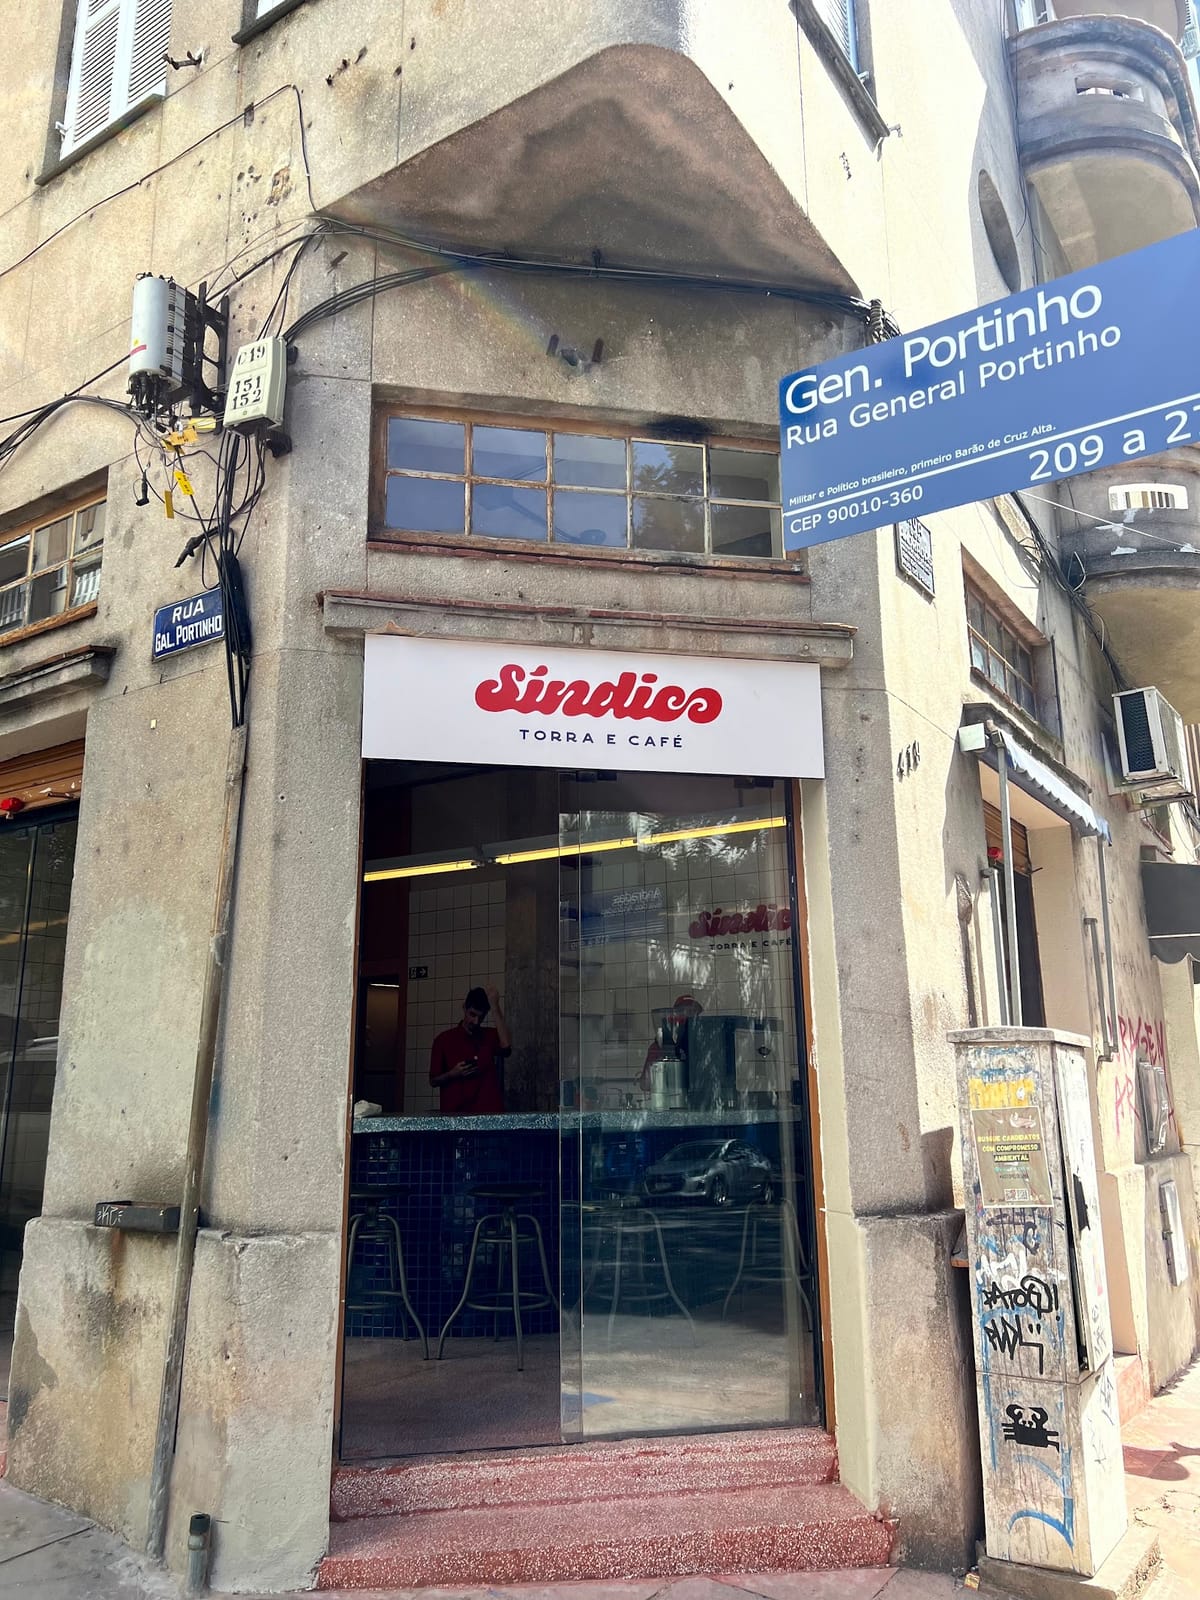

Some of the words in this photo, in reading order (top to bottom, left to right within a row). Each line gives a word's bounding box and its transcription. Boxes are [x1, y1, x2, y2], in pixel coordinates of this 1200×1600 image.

[238, 346, 266, 365] C19
[785, 364, 883, 414] Gen.
[903, 284, 1103, 378] Portinho
[233, 389, 261, 410] 152
[235, 375, 261, 394] 151
[786, 418, 838, 449] Rua
[849, 370, 965, 428] General
[979, 325, 1121, 388] Portinho
[1028, 434, 1104, 481] 209
[1122, 429, 1146, 455] a
[1164, 404, 1200, 444] 2
[789, 491, 817, 507] Militar
[818, 490, 825, 498] e
[827, 480, 860, 496] Político
[861, 466, 909, 486] brasileiro,
[910, 453, 952, 474] primeiro
[954, 442, 985, 459] Barão
[987, 438, 1001, 449] de
[1003, 430, 1029, 444] Cruz
[1030, 422, 1057, 437] Alta.
[789, 513, 823, 535] CEP
[826, 485, 924, 525] 90010-360
[172, 598, 205, 624] RUA
[176, 614, 223, 646] PORTINHO
[474, 663, 723, 724] Síndico
[519, 729, 594, 744] TORRA
[606, 734, 617, 745] E
[628, 735, 683, 748] CAFÉ
[996, 1144, 1038, 1152] COMPROMISSO
